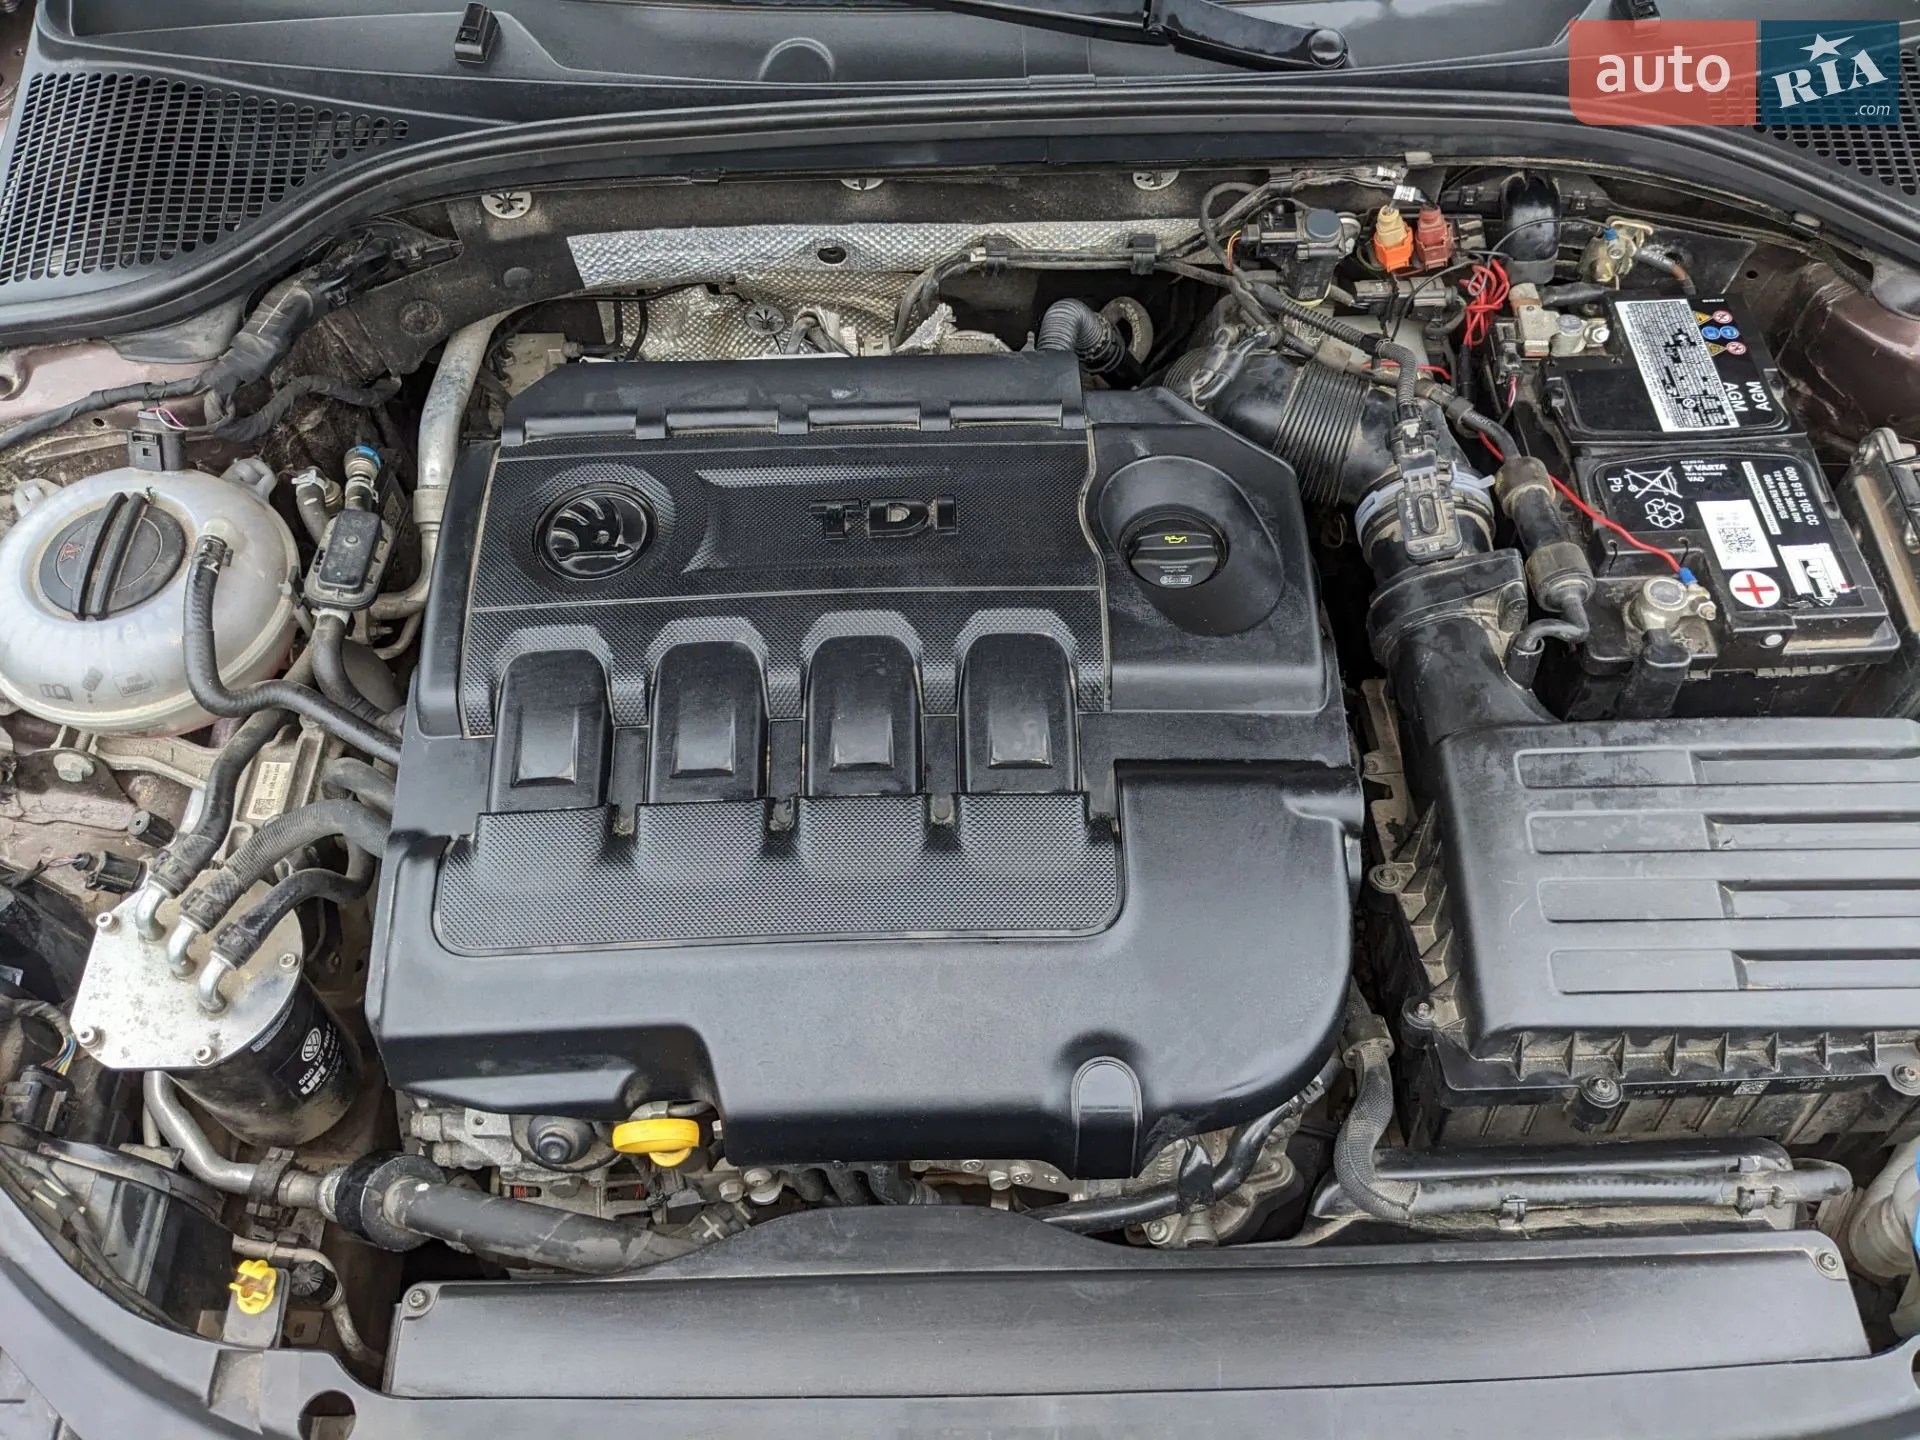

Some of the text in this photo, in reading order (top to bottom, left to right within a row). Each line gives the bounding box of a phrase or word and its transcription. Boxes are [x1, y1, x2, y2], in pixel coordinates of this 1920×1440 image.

[1723, 382, 1748, 412] AGM
[1746, 381, 1771, 412] AGM
[1607, 477, 1622, 493] Pb
[1784, 466, 1820, 526] 000 915 105 CC
[809, 494, 959, 541] TDI
[300, 1065, 327, 1095] UFI
